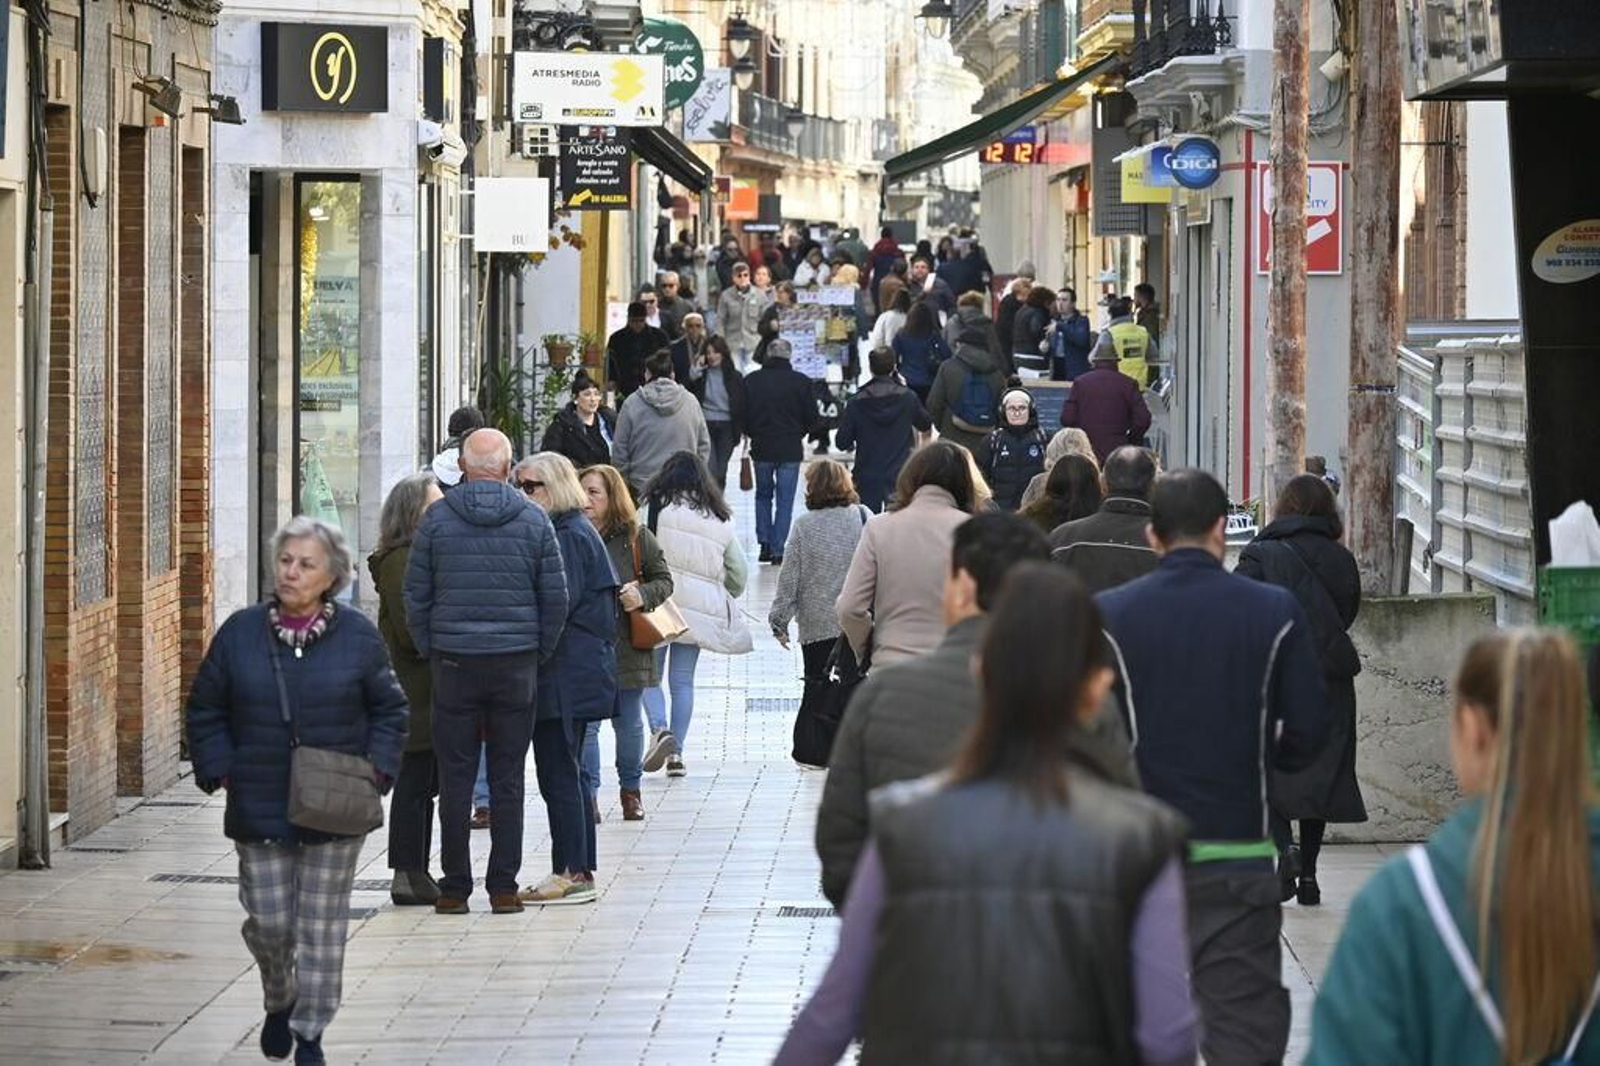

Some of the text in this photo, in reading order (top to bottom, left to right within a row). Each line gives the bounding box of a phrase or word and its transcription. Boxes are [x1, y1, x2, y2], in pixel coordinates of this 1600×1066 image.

[532, 69, 600, 78] ATRESMEDIA
[572, 79, 601, 87] RADIO
[986, 142, 1033, 162] 12 12
[1172, 159, 1218, 169] DIGI
[313, 281, 353, 290] UELVA
